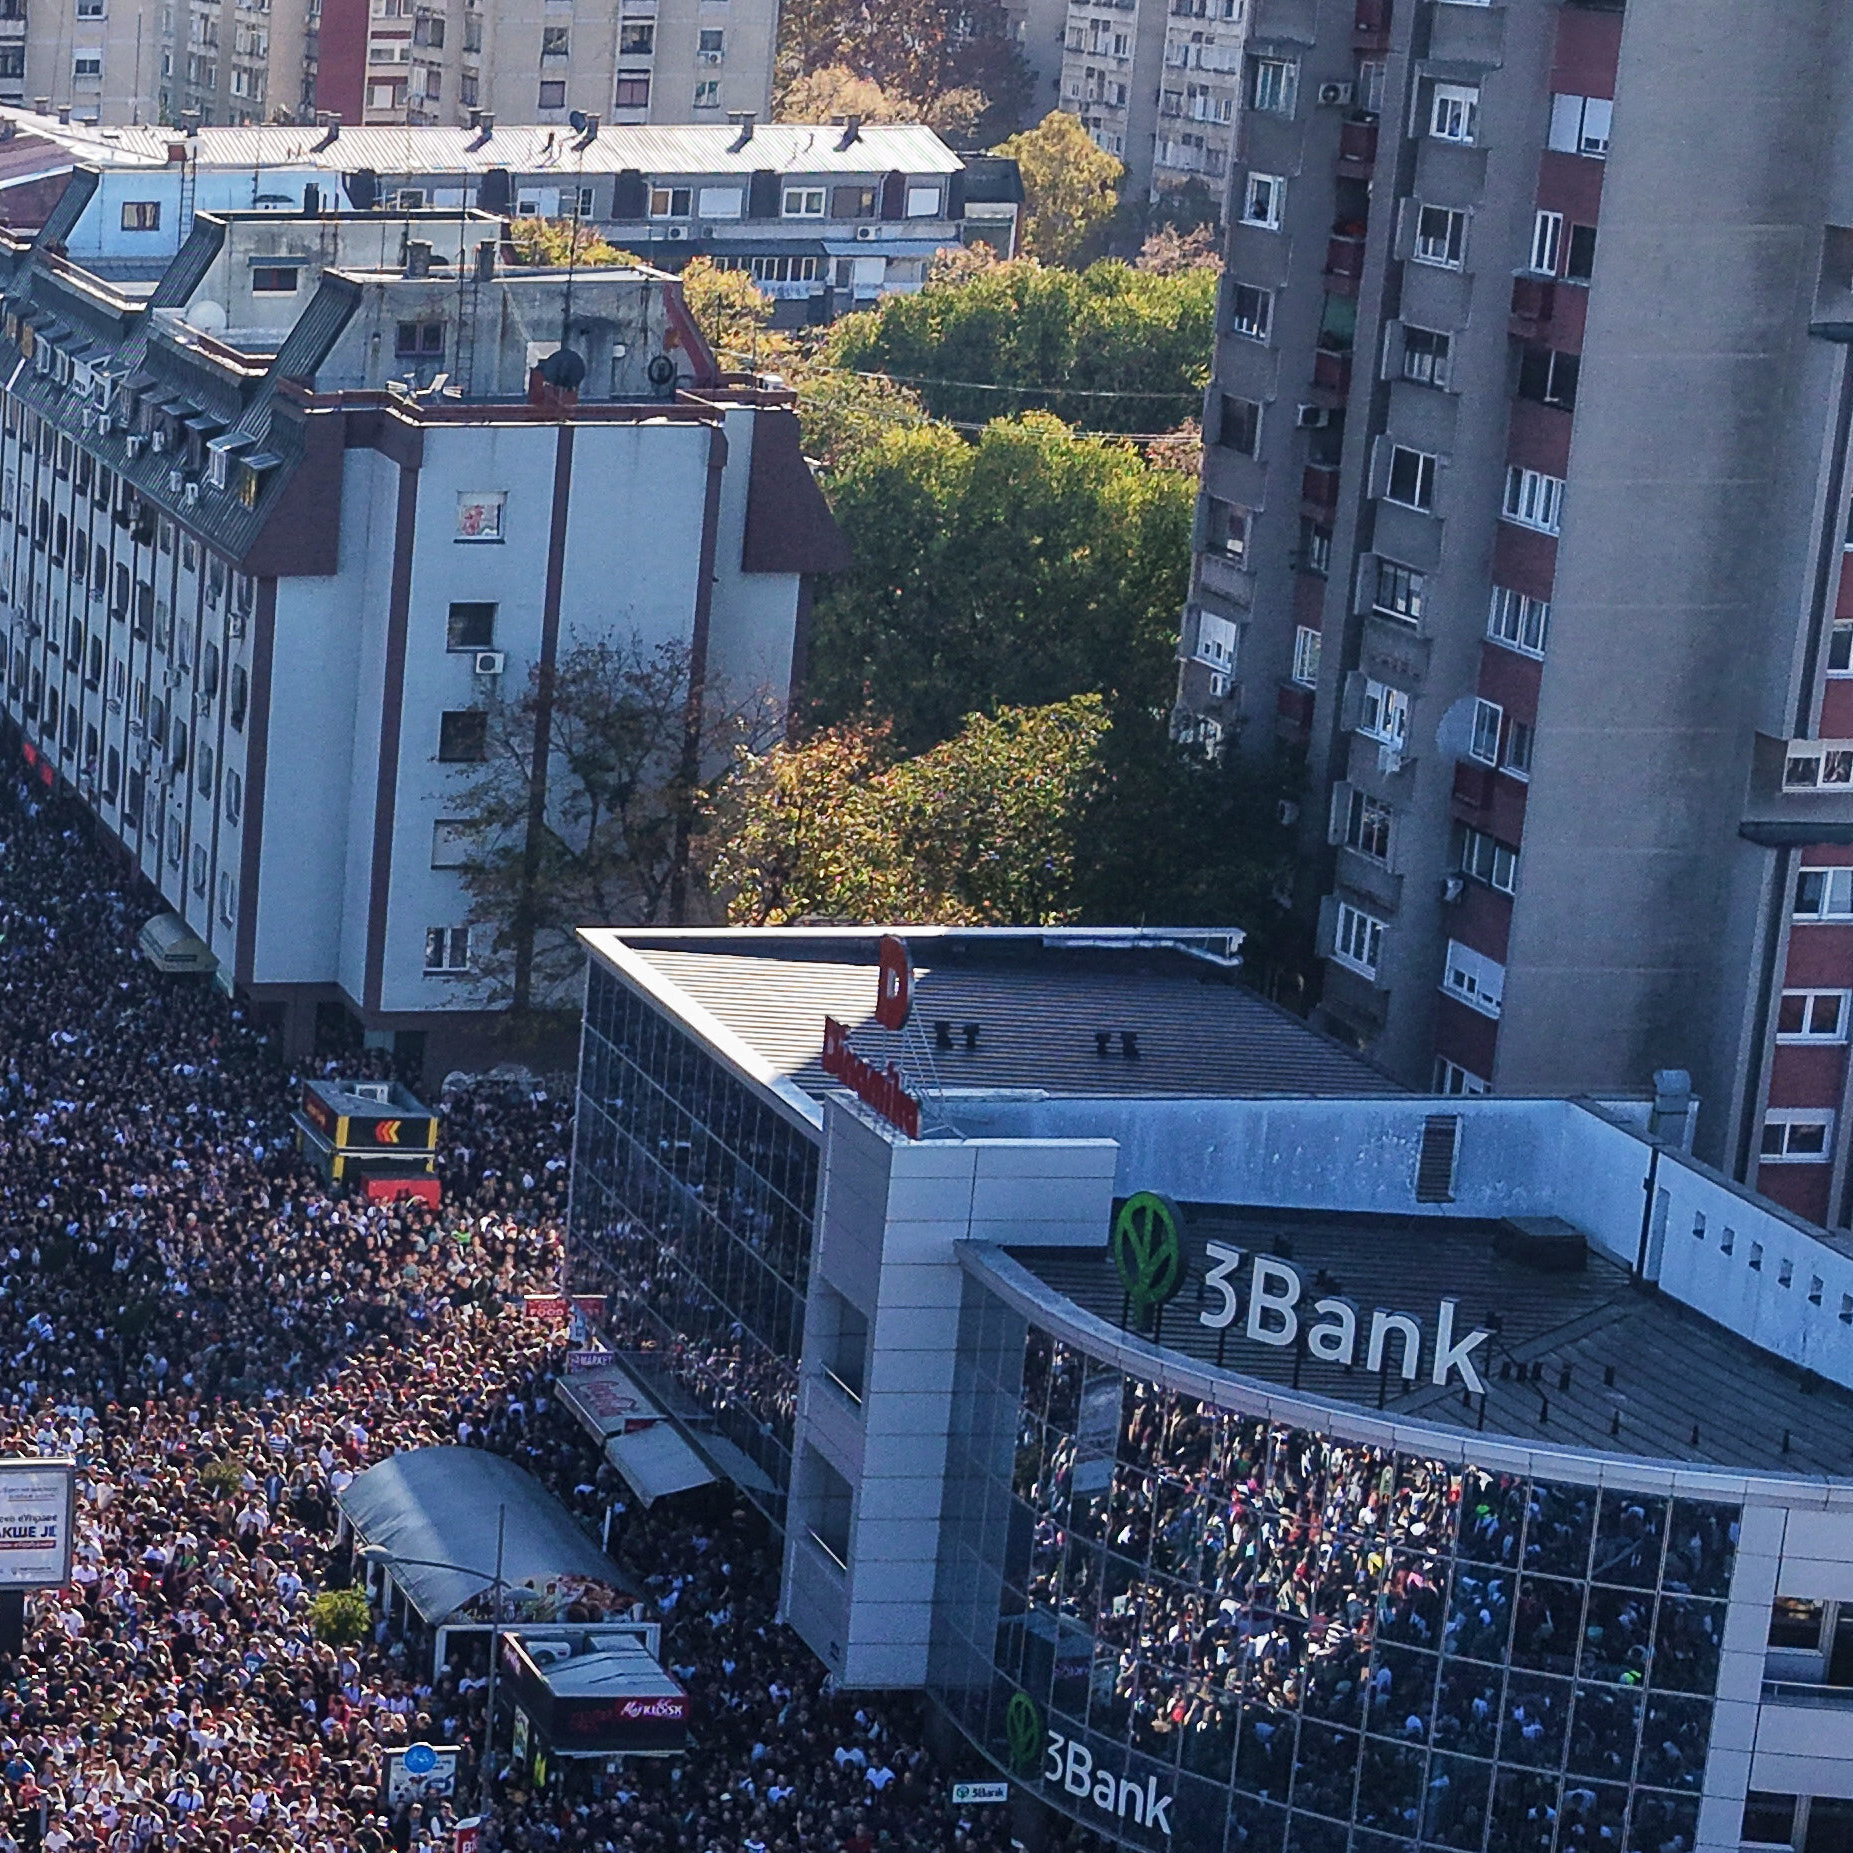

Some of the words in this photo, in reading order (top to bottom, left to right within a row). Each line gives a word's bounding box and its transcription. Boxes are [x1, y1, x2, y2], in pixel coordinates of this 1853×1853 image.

[1199, 1240, 1494, 1395] 3Bank
[40, 1525, 57, 1537] ЈЕ
[1045, 1730, 1172, 1834] 3Bank
